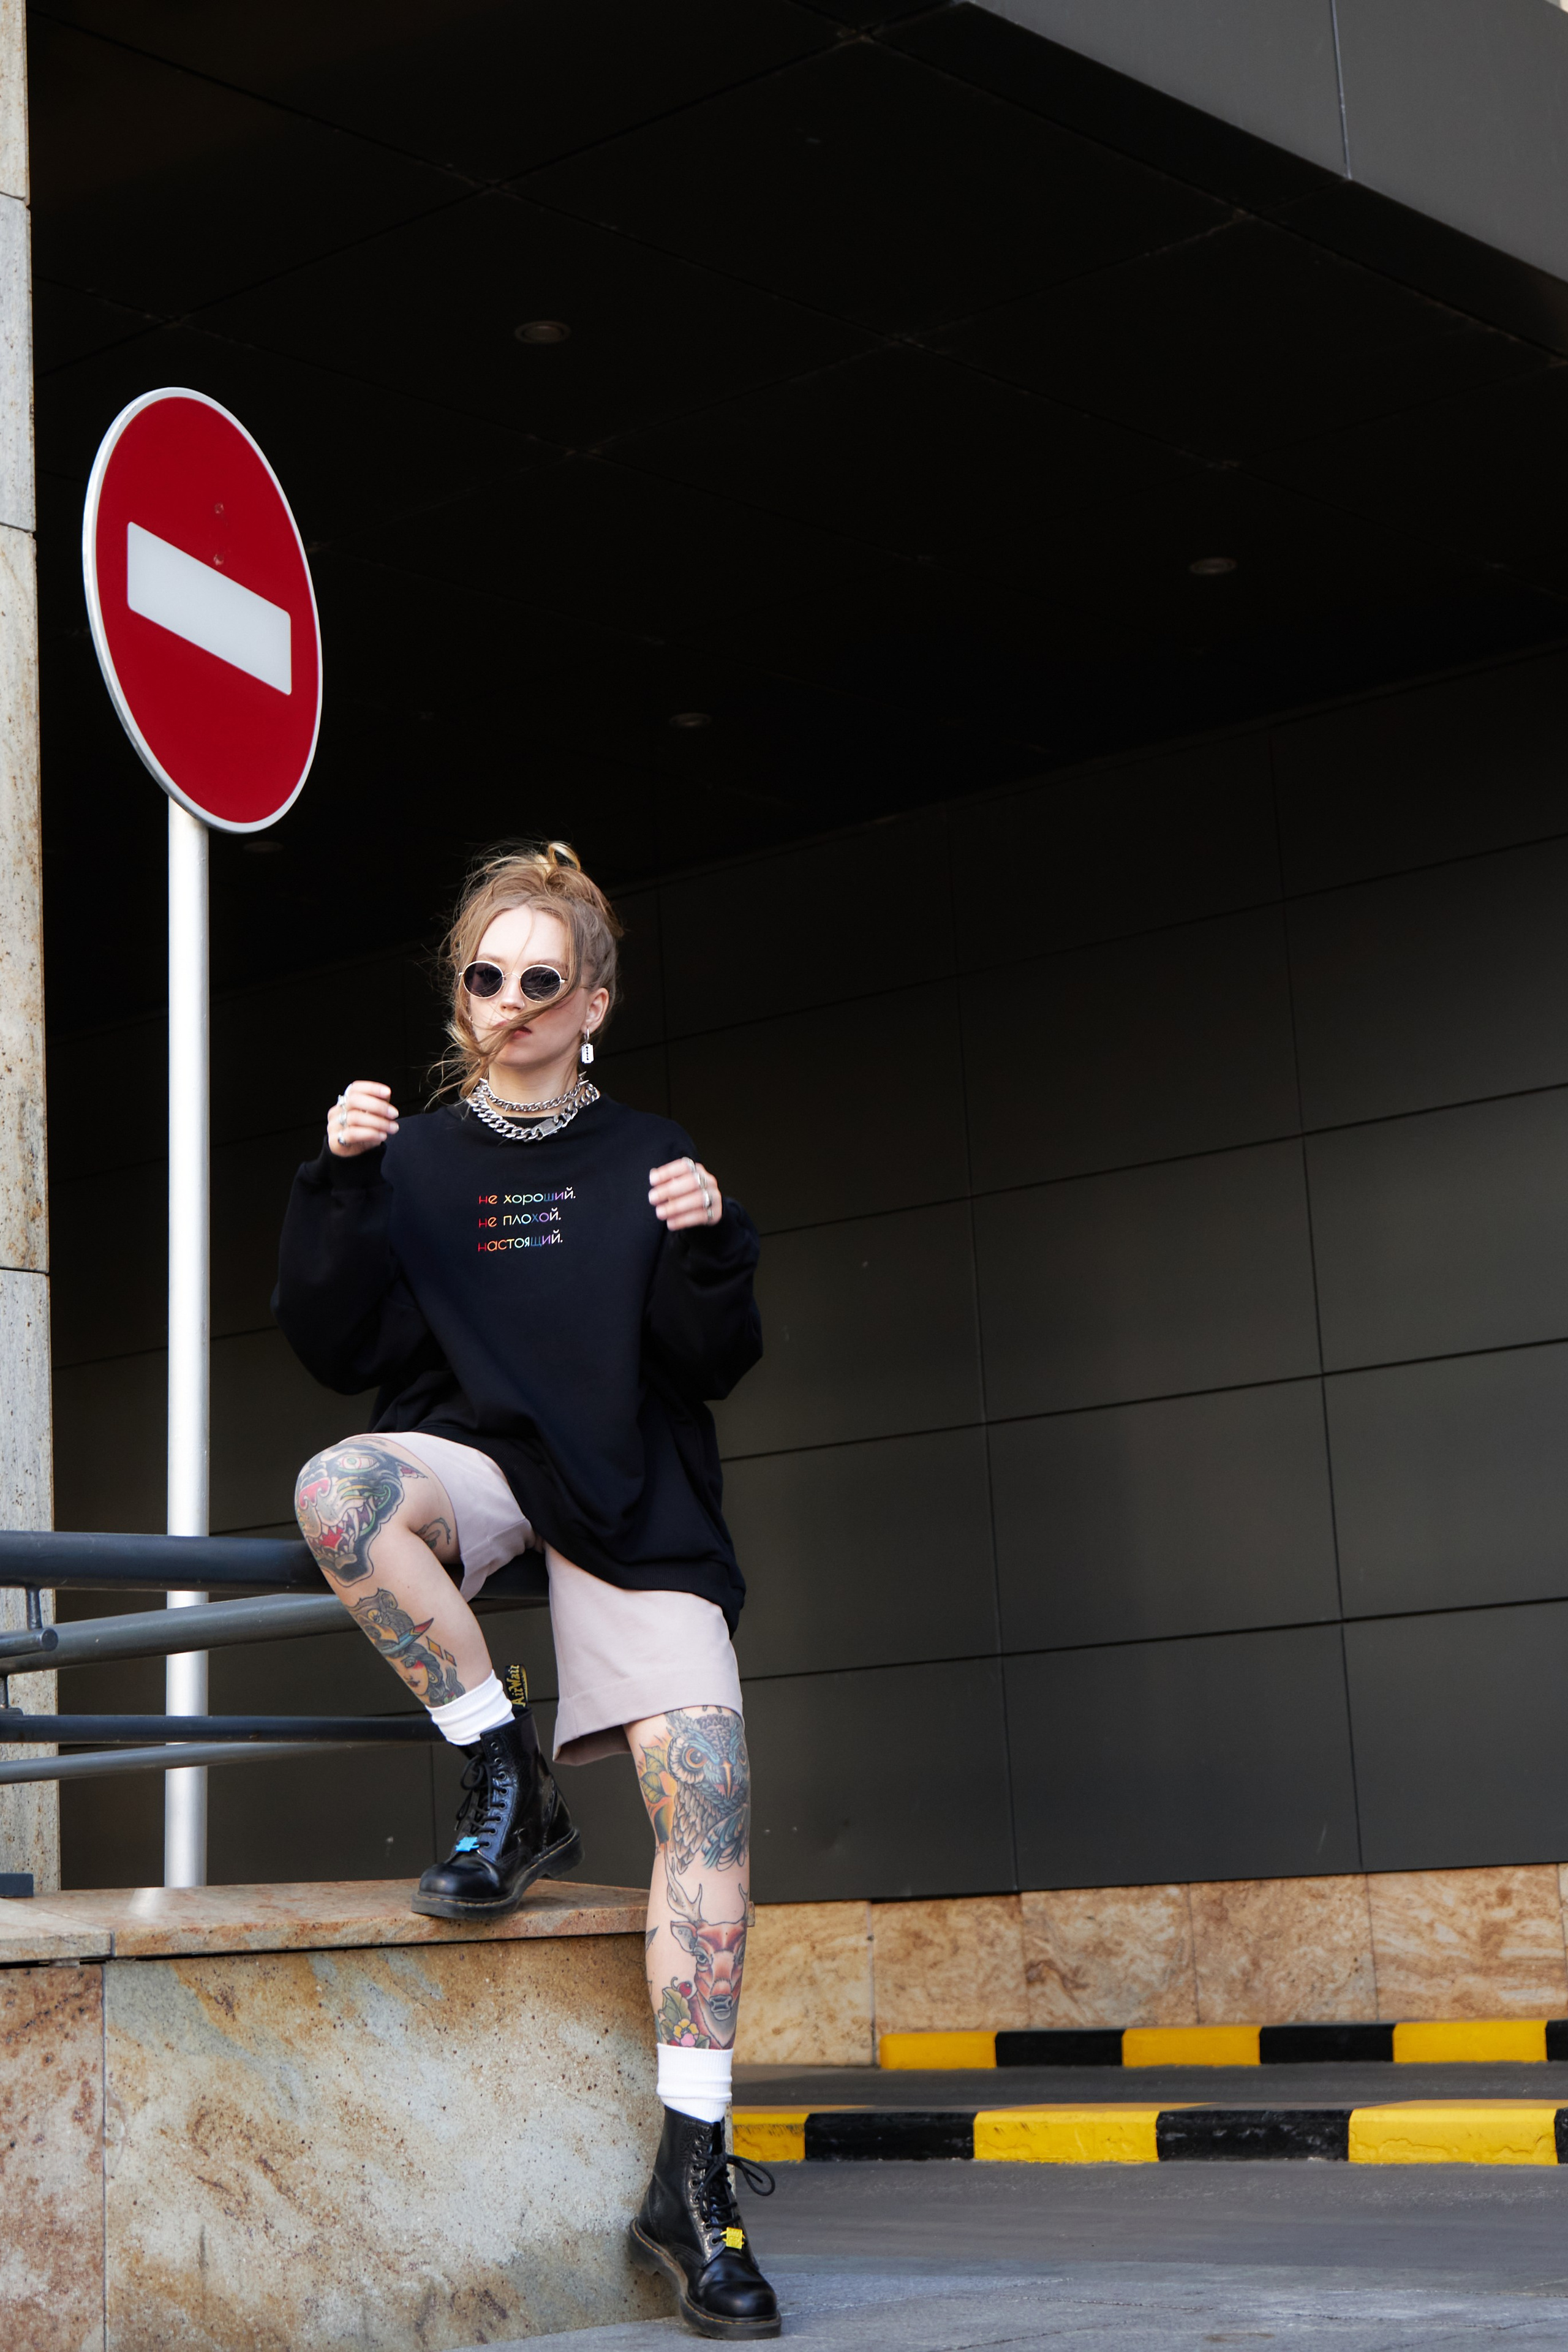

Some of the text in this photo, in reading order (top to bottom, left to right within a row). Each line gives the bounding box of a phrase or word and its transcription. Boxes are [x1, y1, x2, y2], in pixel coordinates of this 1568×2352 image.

[478, 1186, 576, 1205] не хороший.
[478, 1207, 562, 1228] не плохой.
[477, 1229, 564, 1252] настоящий.
